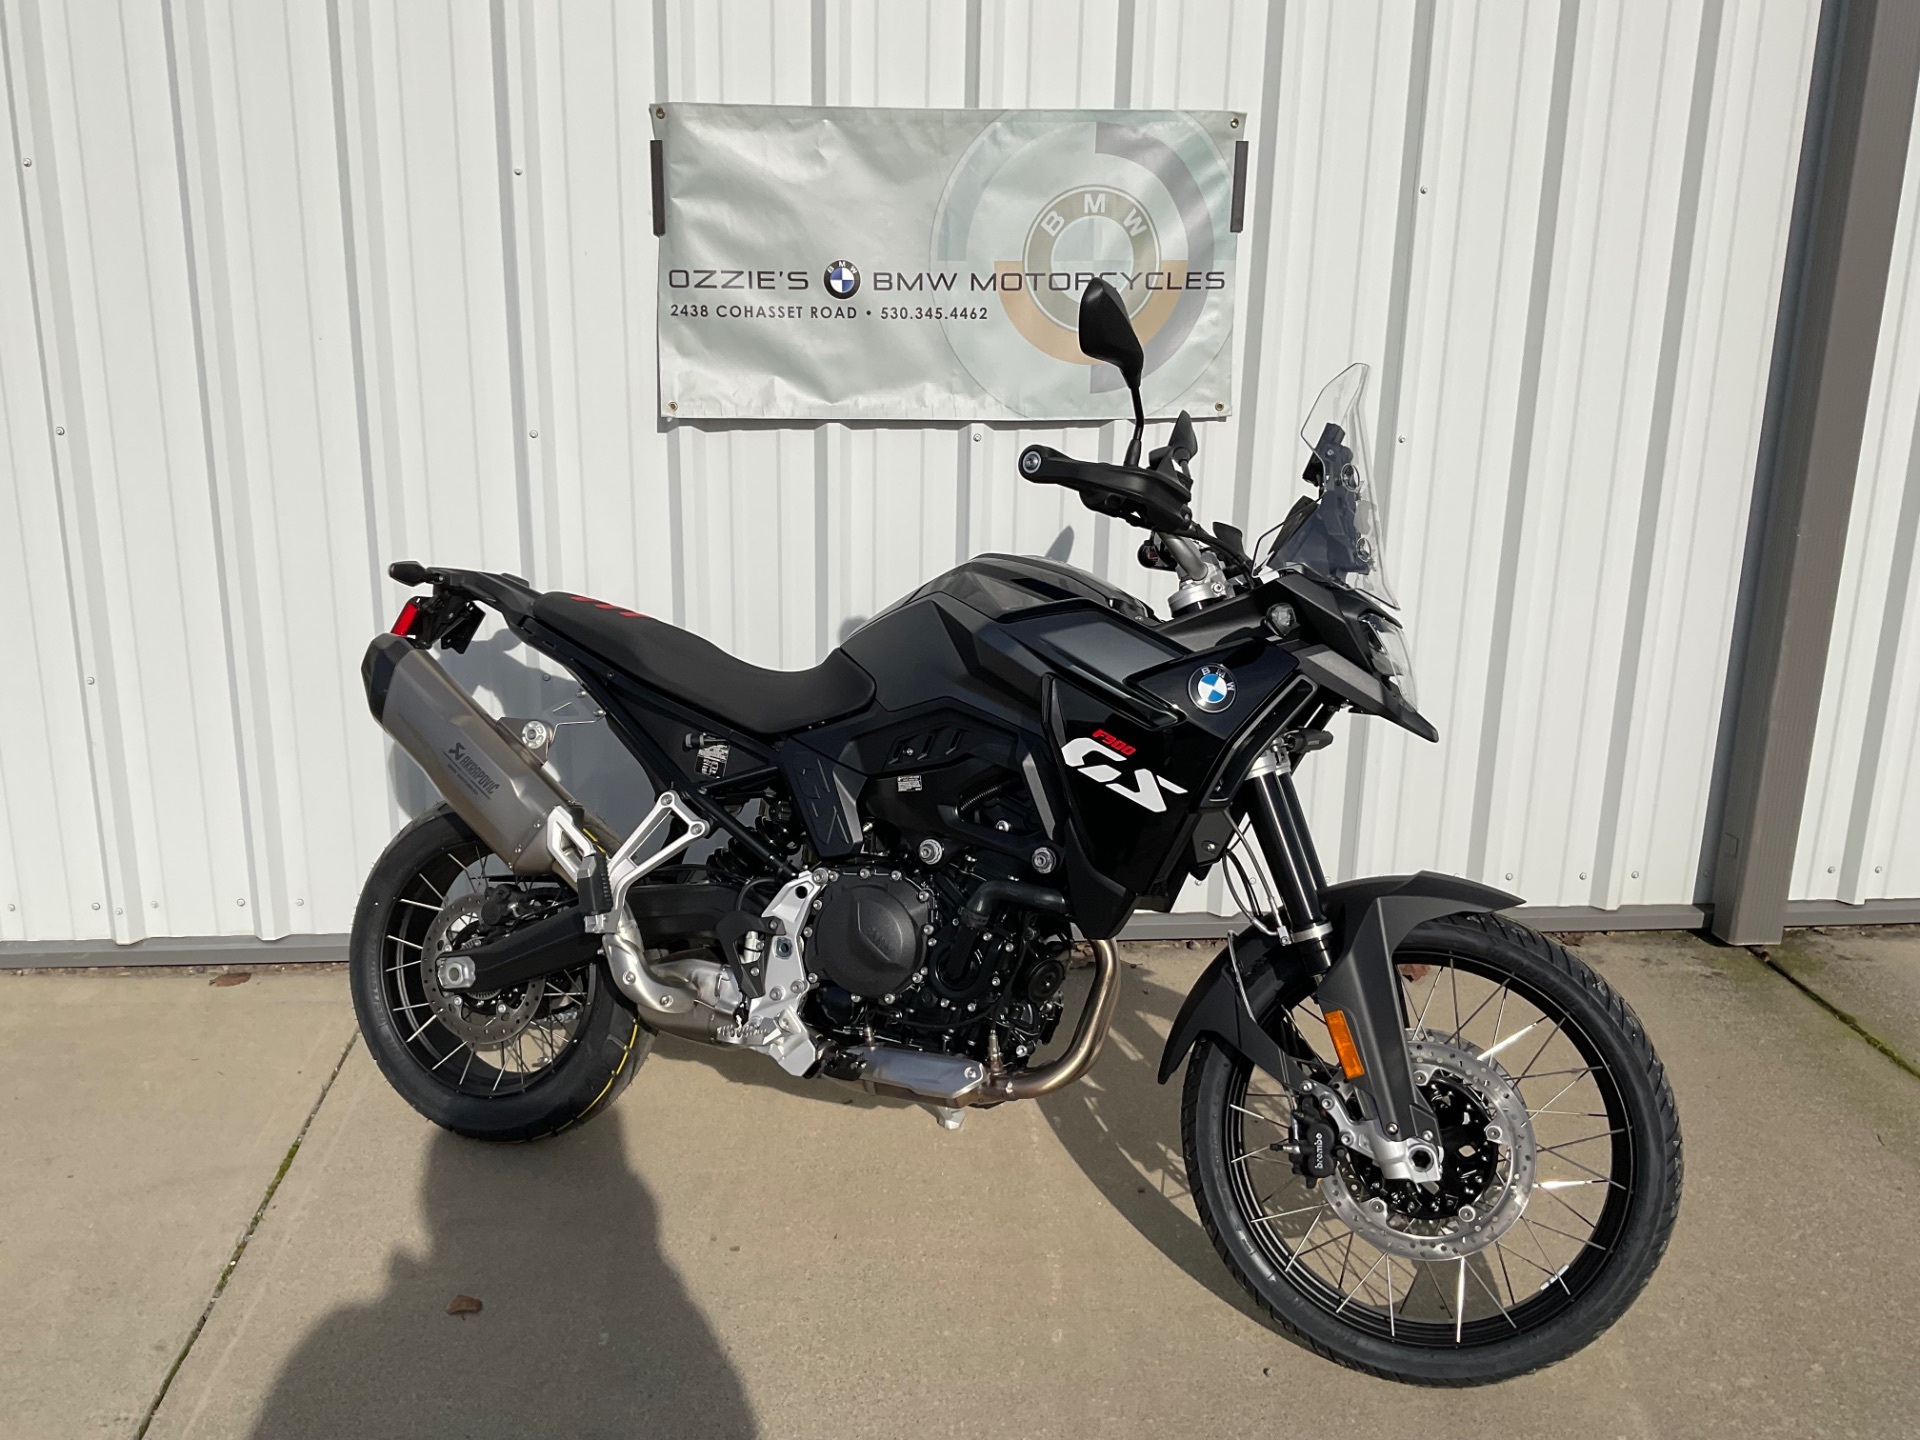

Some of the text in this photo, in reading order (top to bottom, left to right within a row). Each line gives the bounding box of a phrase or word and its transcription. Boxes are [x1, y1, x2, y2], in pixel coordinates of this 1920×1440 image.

[1040, 193, 1148, 237] BMW
[669, 269, 809, 290] OZZIE'S
[873, 272, 957, 291] BMW
[670, 304, 988, 320] 2438 COHASSET ROAD 530.345.4462
[1092, 728, 1136, 756] F900
[1314, 1132, 1323, 1169] brembo
